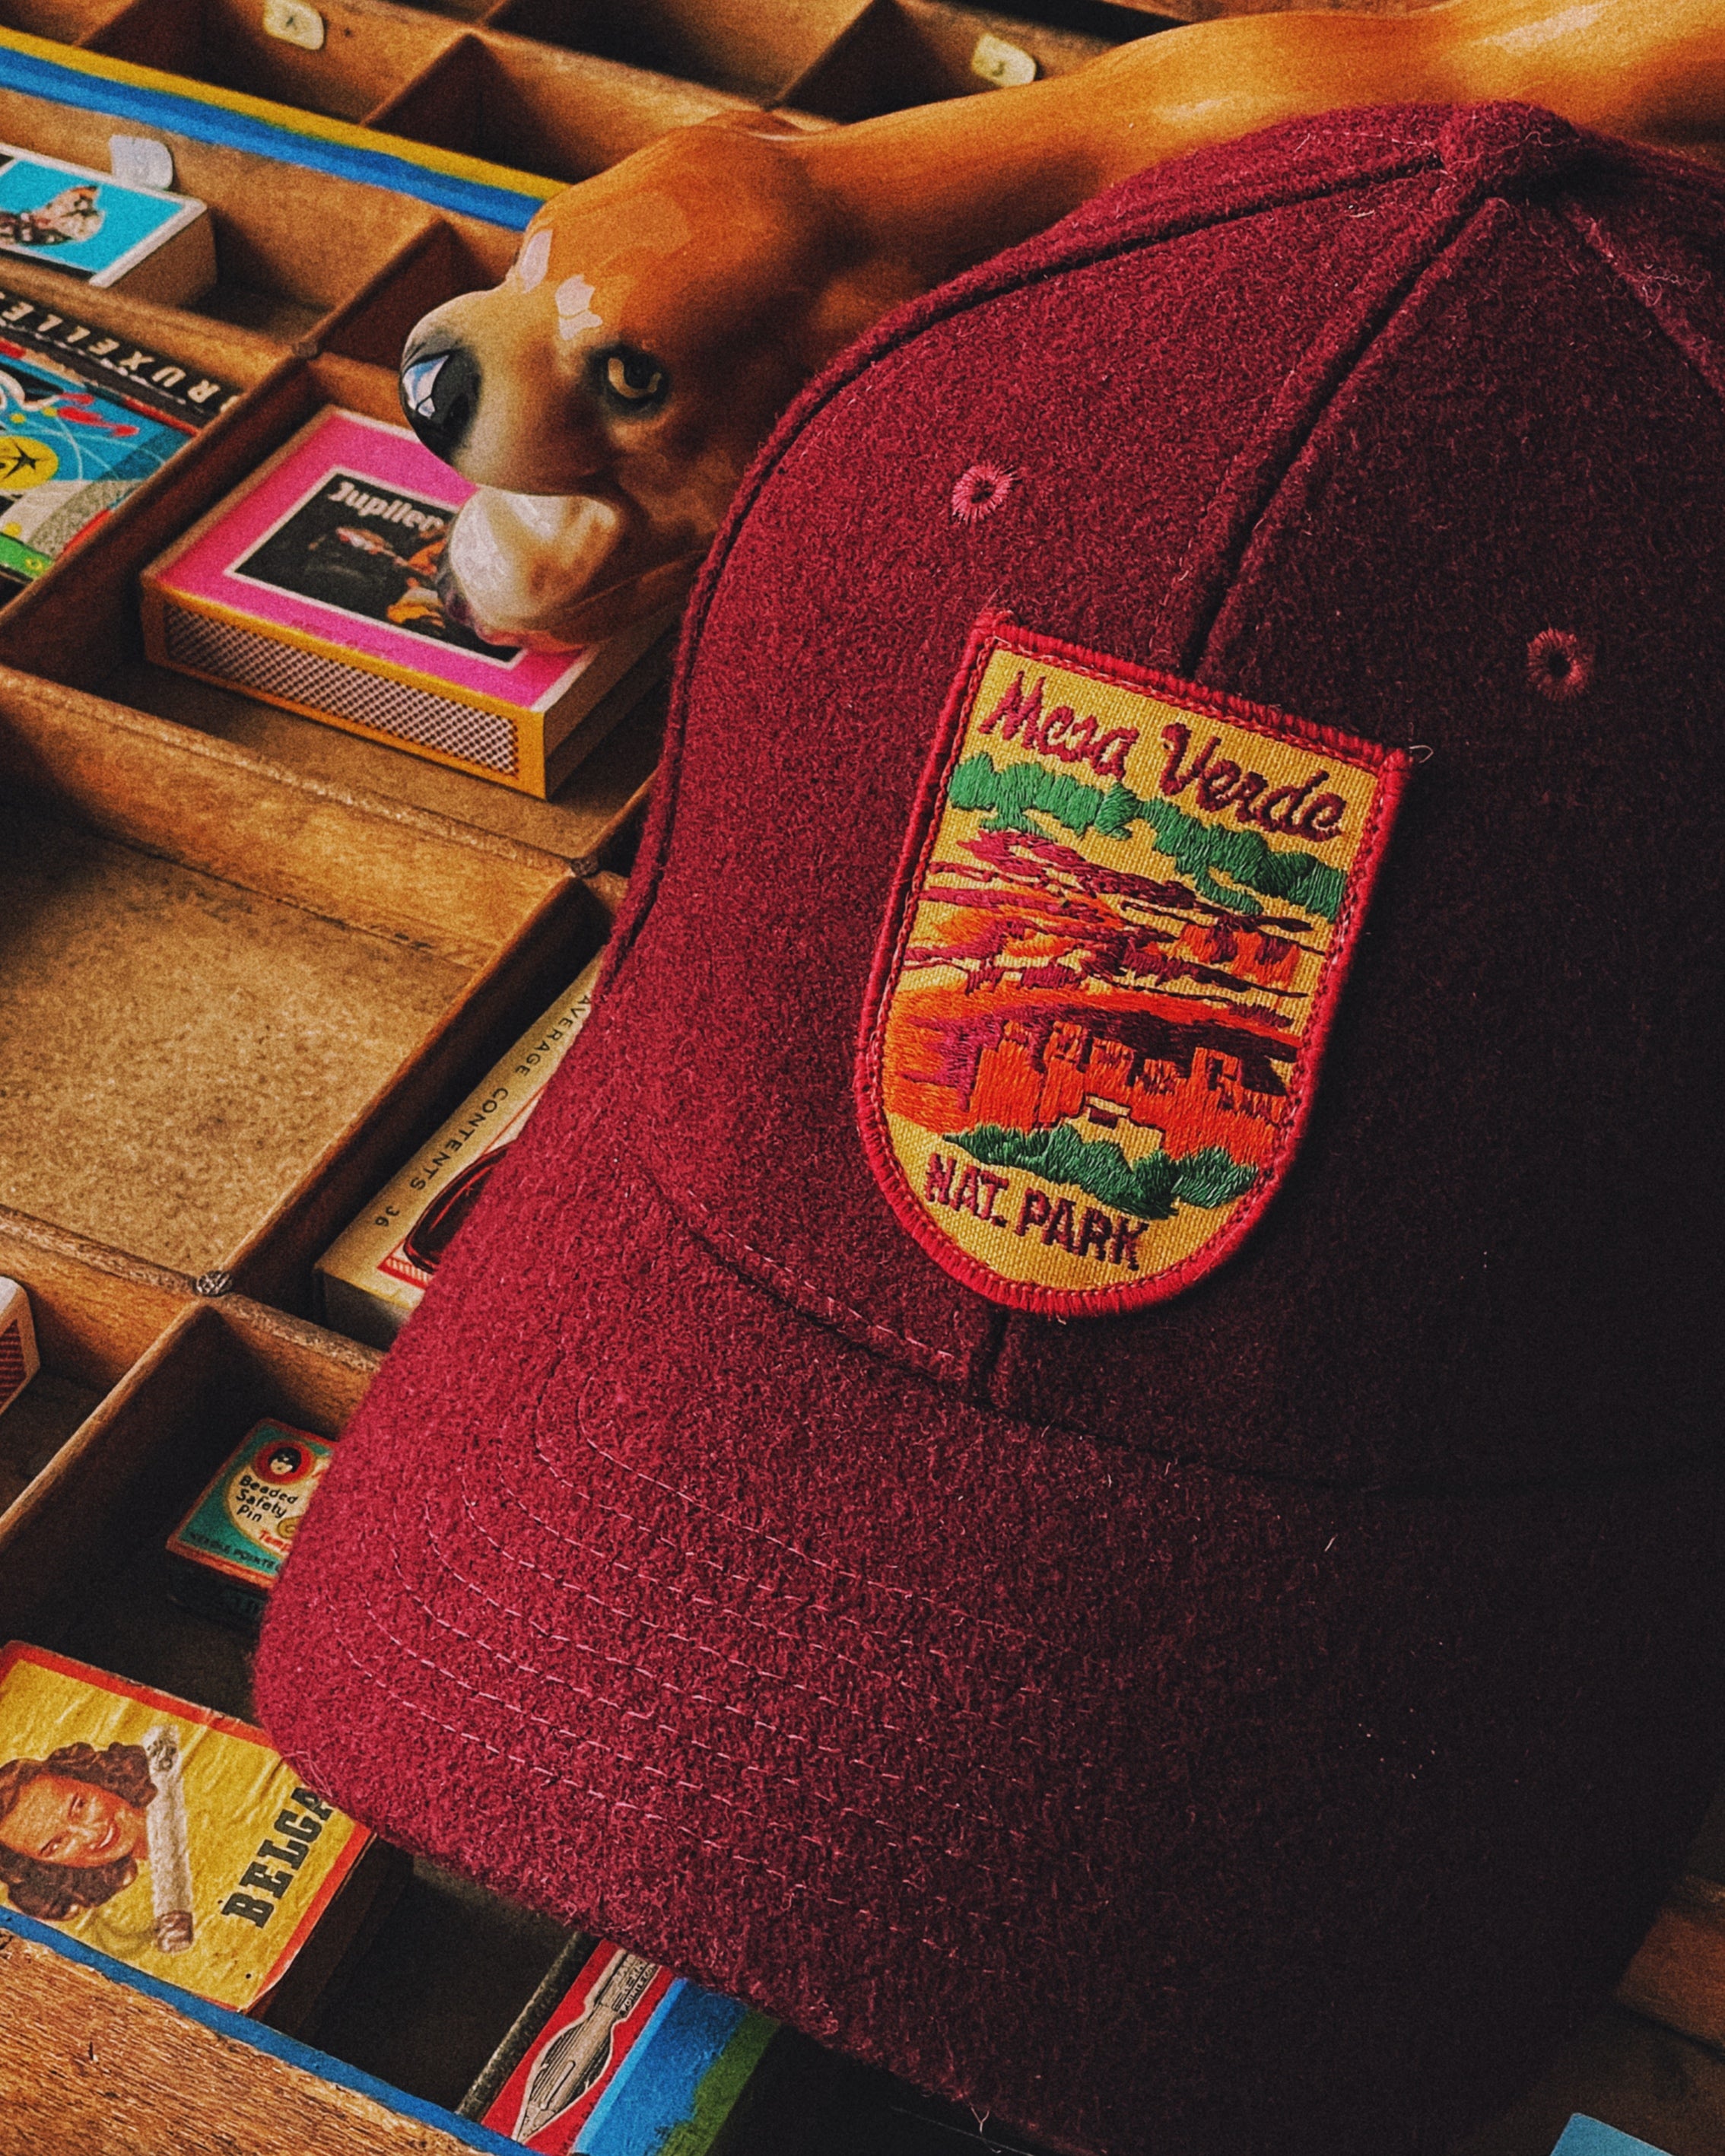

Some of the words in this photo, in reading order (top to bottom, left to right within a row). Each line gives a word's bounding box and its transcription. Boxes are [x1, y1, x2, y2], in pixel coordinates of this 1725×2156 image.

[0, 292, 240, 414] RUXELLE
[978, 670, 1140, 780] Mesa
[1158, 722, 1348, 842] Verde
[514, 995, 592, 1077] AVERAGE
[410, 1087, 509, 1191] CONTENTS
[374, 1206, 400, 1227] 36
[925, 1152, 1009, 1228] NAT.
[1015, 1186, 1149, 1271] PARK
[236, 1488, 288, 1519] Safety
[237, 1503, 263, 1523] Pin
[239, 1475, 299, 1505] Beaded
[221, 1787, 334, 1929] BELGA
